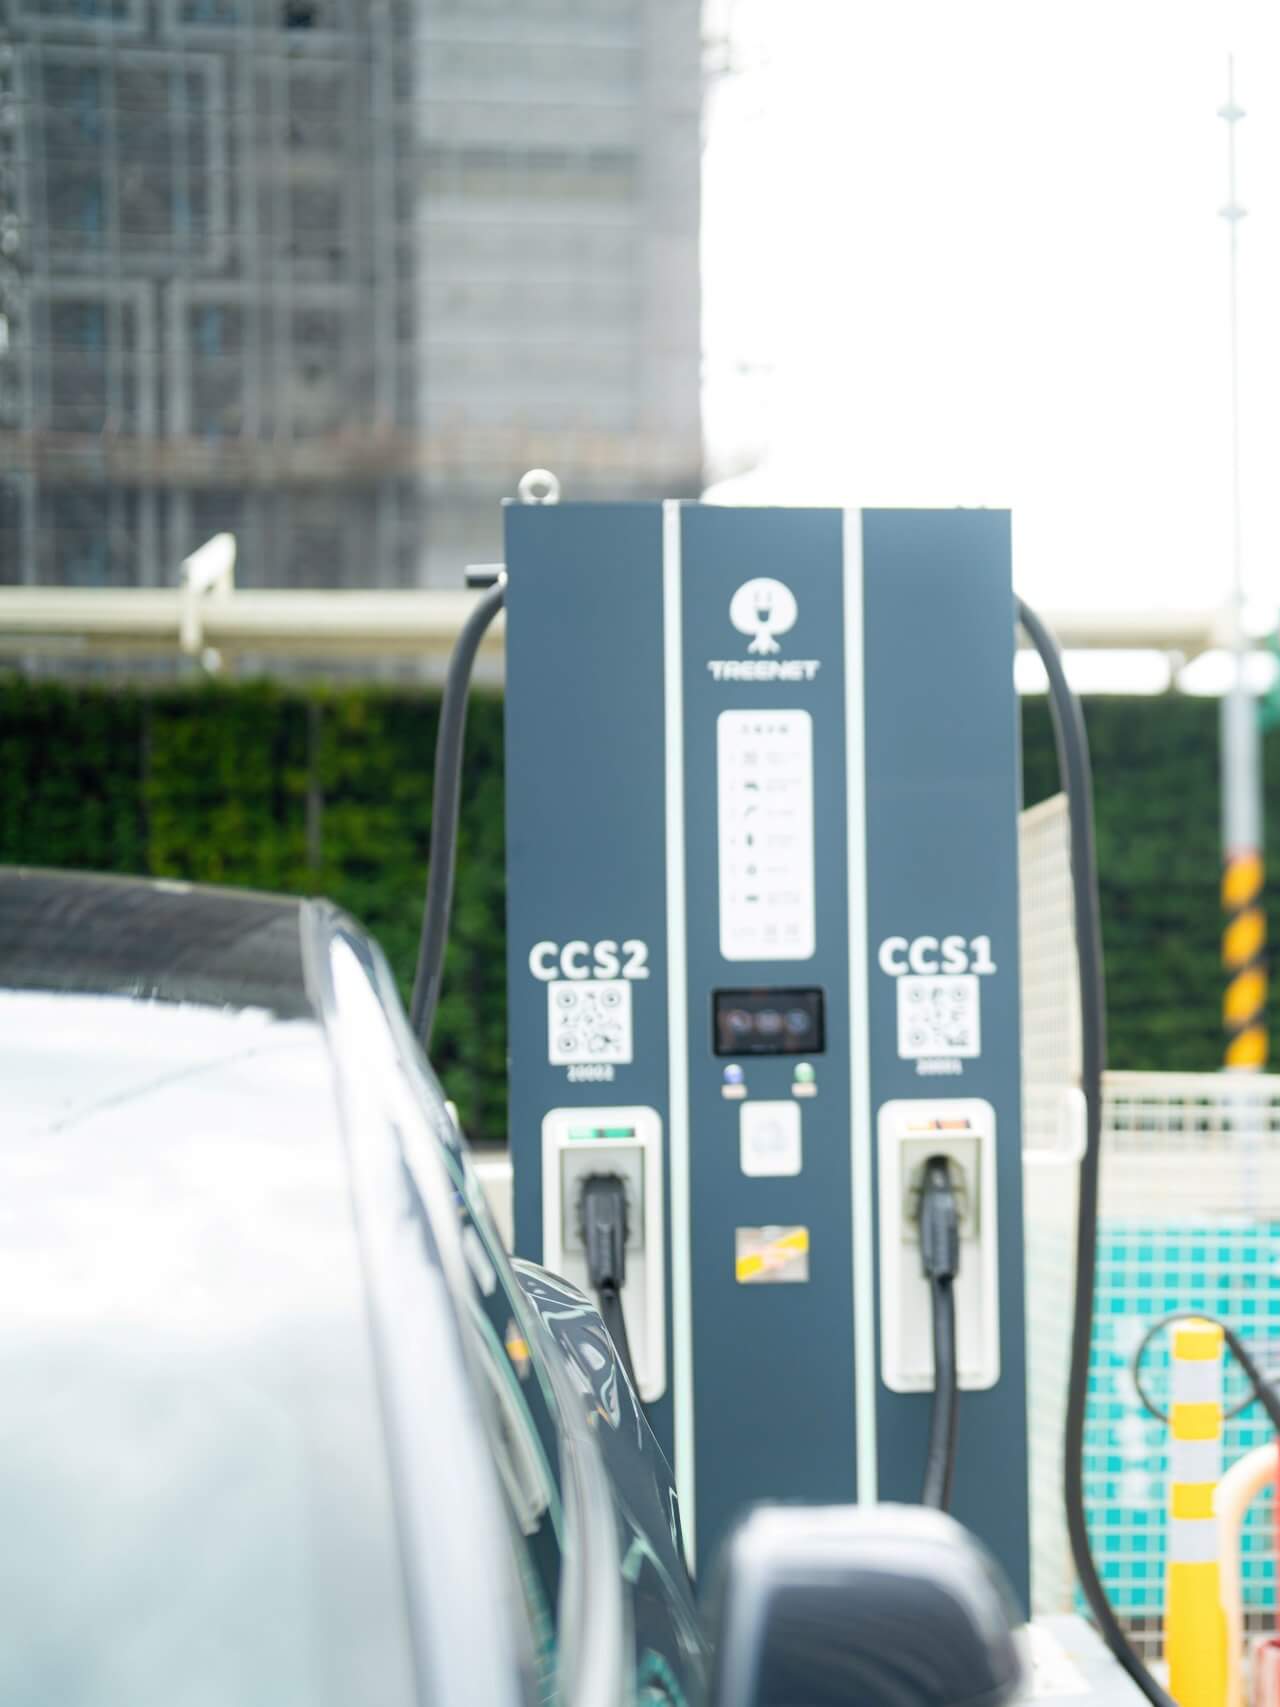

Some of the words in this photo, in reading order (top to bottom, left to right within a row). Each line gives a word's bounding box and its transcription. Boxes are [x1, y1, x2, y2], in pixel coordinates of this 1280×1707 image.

[707, 659, 820, 680] TREENET
[529, 939, 650, 981] CCS2
[878, 935, 997, 976] CCS1
